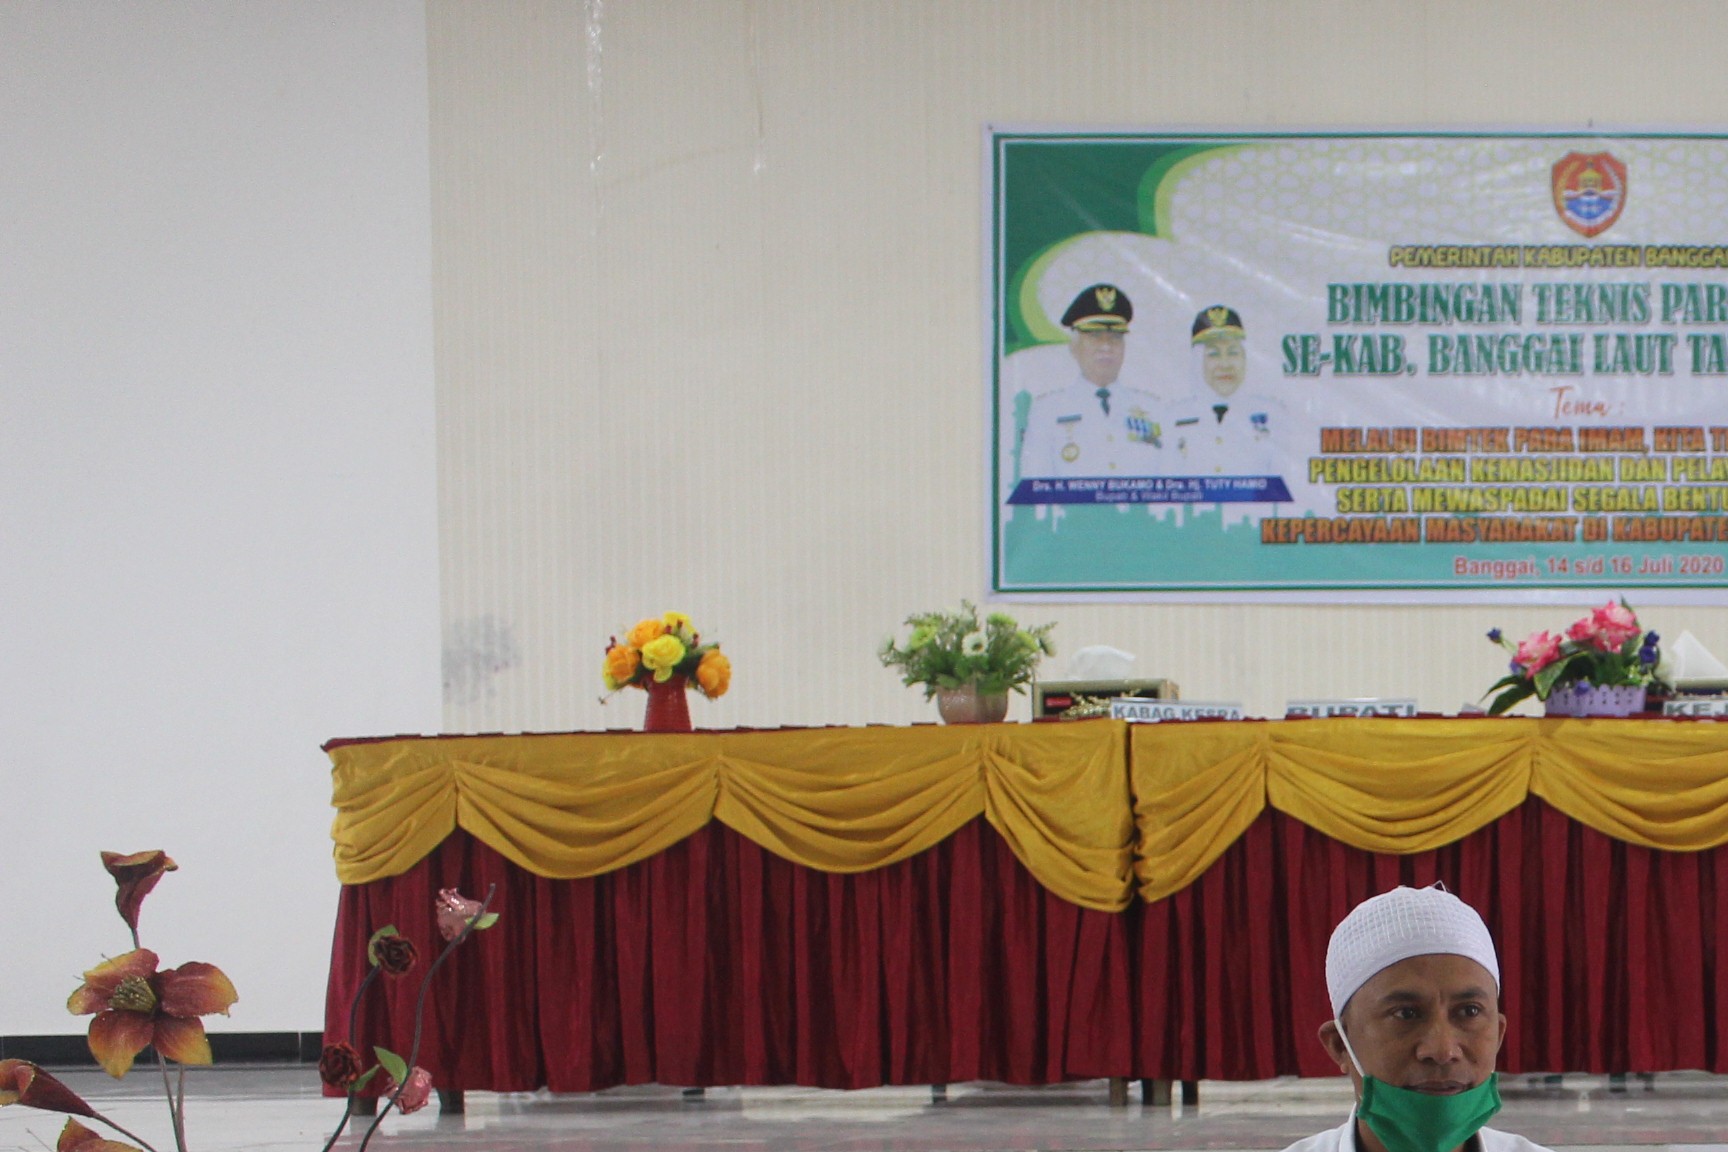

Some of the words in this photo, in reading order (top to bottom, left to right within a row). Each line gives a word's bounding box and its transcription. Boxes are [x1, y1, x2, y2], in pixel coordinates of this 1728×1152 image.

[1389, 245, 1518, 268] PEMERINTAH
[1522, 245, 1641, 268] KABUPATEN
[1326, 283, 1522, 325] BIMBINGAN
[1532, 283, 1651, 325] TEKNIS
[1281, 333, 1417, 376] SE-KAB.
[1427, 333, 1585, 376] BANGGAI
[1593, 333, 1678, 376] LAUT
[1550, 386, 1609, 419] Tema
[1320, 427, 1418, 453] MELALUI
[1514, 427, 1574, 453] PARA
[1653, 427, 1706, 451] KITA
[1309, 456, 1466, 483] PENGELOLAAN
[1470, 456, 1615, 483] KEMASJIDAN
[1619, 456, 1666, 482] DAN
[1336, 486, 1409, 512] SERTA
[1412, 486, 1568, 512] MEWASPADAI
[1572, 486, 1658, 512] SEGALA
[1261, 517, 1420, 543] KEPERCAYAAN
[1425, 516, 1578, 543] MASYARAKAT
[1582, 516, 1608, 542] DI
[1454, 556, 1540, 579] Banggai,
[1547, 557, 1568, 574] 14
[1574, 556, 1604, 574] s/d
[1610, 556, 1632, 574] 16
[1638, 556, 1673, 574] Juli
[1679, 556, 1725, 574] 2020
[1113, 704, 1175, 720] KABAG
